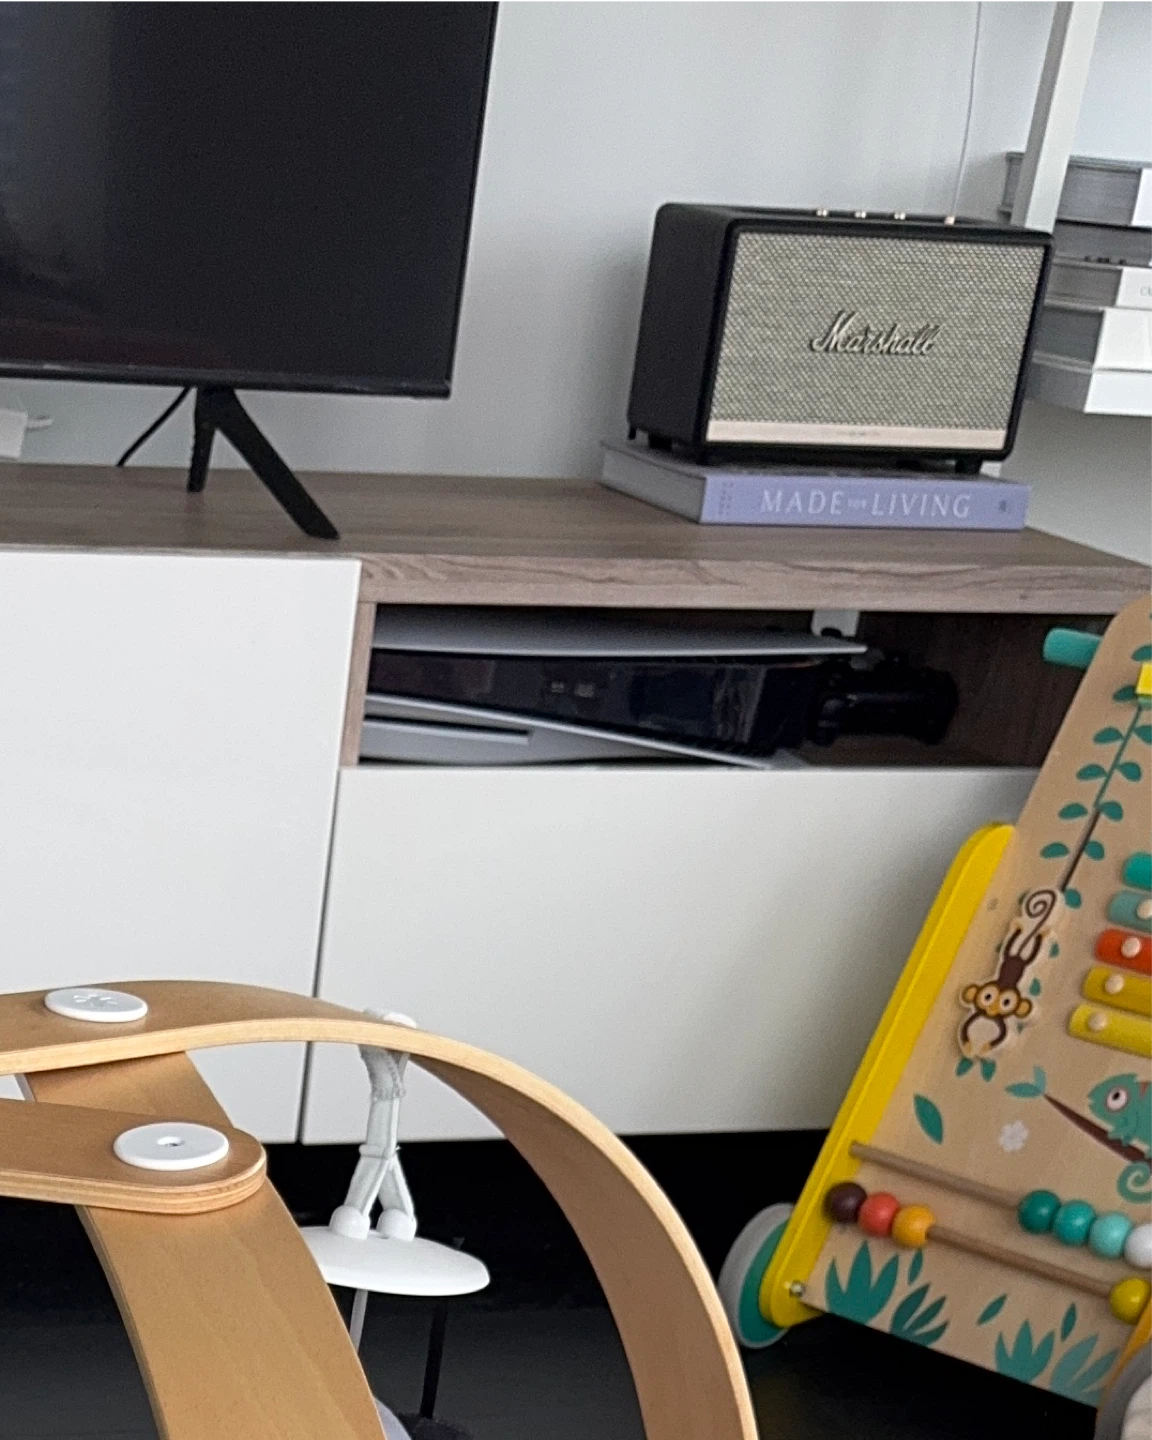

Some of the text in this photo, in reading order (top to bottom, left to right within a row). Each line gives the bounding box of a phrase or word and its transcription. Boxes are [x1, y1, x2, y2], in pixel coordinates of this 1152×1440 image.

[809, 309, 943, 356] Marshall
[760, 489, 845, 515] MADE
[871, 493, 972, 519] LIVING
